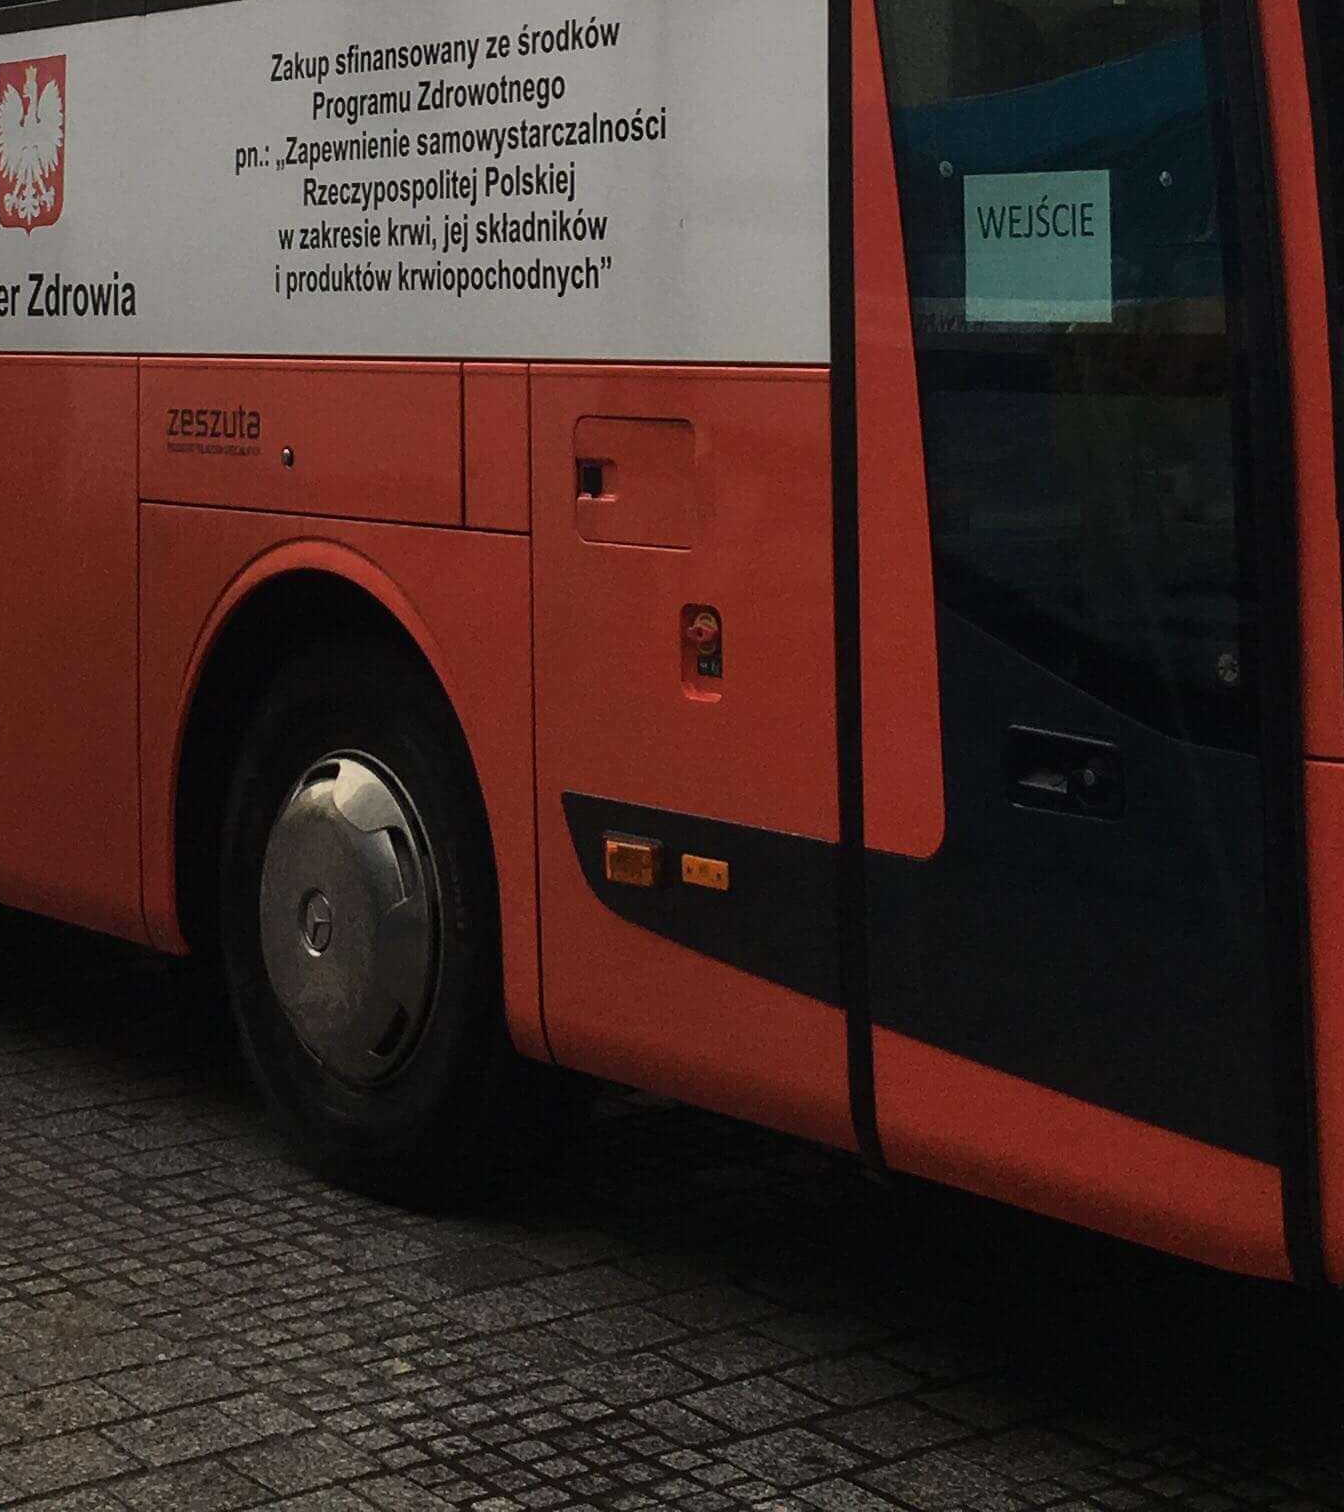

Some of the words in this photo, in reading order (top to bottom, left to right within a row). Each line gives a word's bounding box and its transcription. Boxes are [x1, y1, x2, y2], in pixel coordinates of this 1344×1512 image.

[270, 51, 330, 85] Zakup
[335, 39, 480, 76] sfinansowany
[485, 33, 511, 60] ze
[517, 15, 621, 56] środków
[312, 89, 411, 125] Programu
[417, 75, 566, 111] Zdrowotnego
[235, 145, 270, 176] pn.:
[275, 128, 411, 172] „Zapewnienie
[416, 106, 667, 159] samowystarczalności
[303, 167, 478, 212] Rzeczypospolitej
[485, 161, 576, 202] Polskiej
[278, 228, 295, 250] w
[299, 218, 381, 250] zakresie
[388, 215, 437, 251] krwi,
[442, 213, 469, 253] jej
[476, 208, 608, 244] składników
[976, 194, 1095, 240] WEJŚCIE
[27, 271, 137, 317] Zdrowia
[275, 264, 281, 293] i
[286, 261, 392, 299] produktów
[398, 255, 612, 298] krwiopochodnych”
[166, 405, 261, 439] zeszuta
